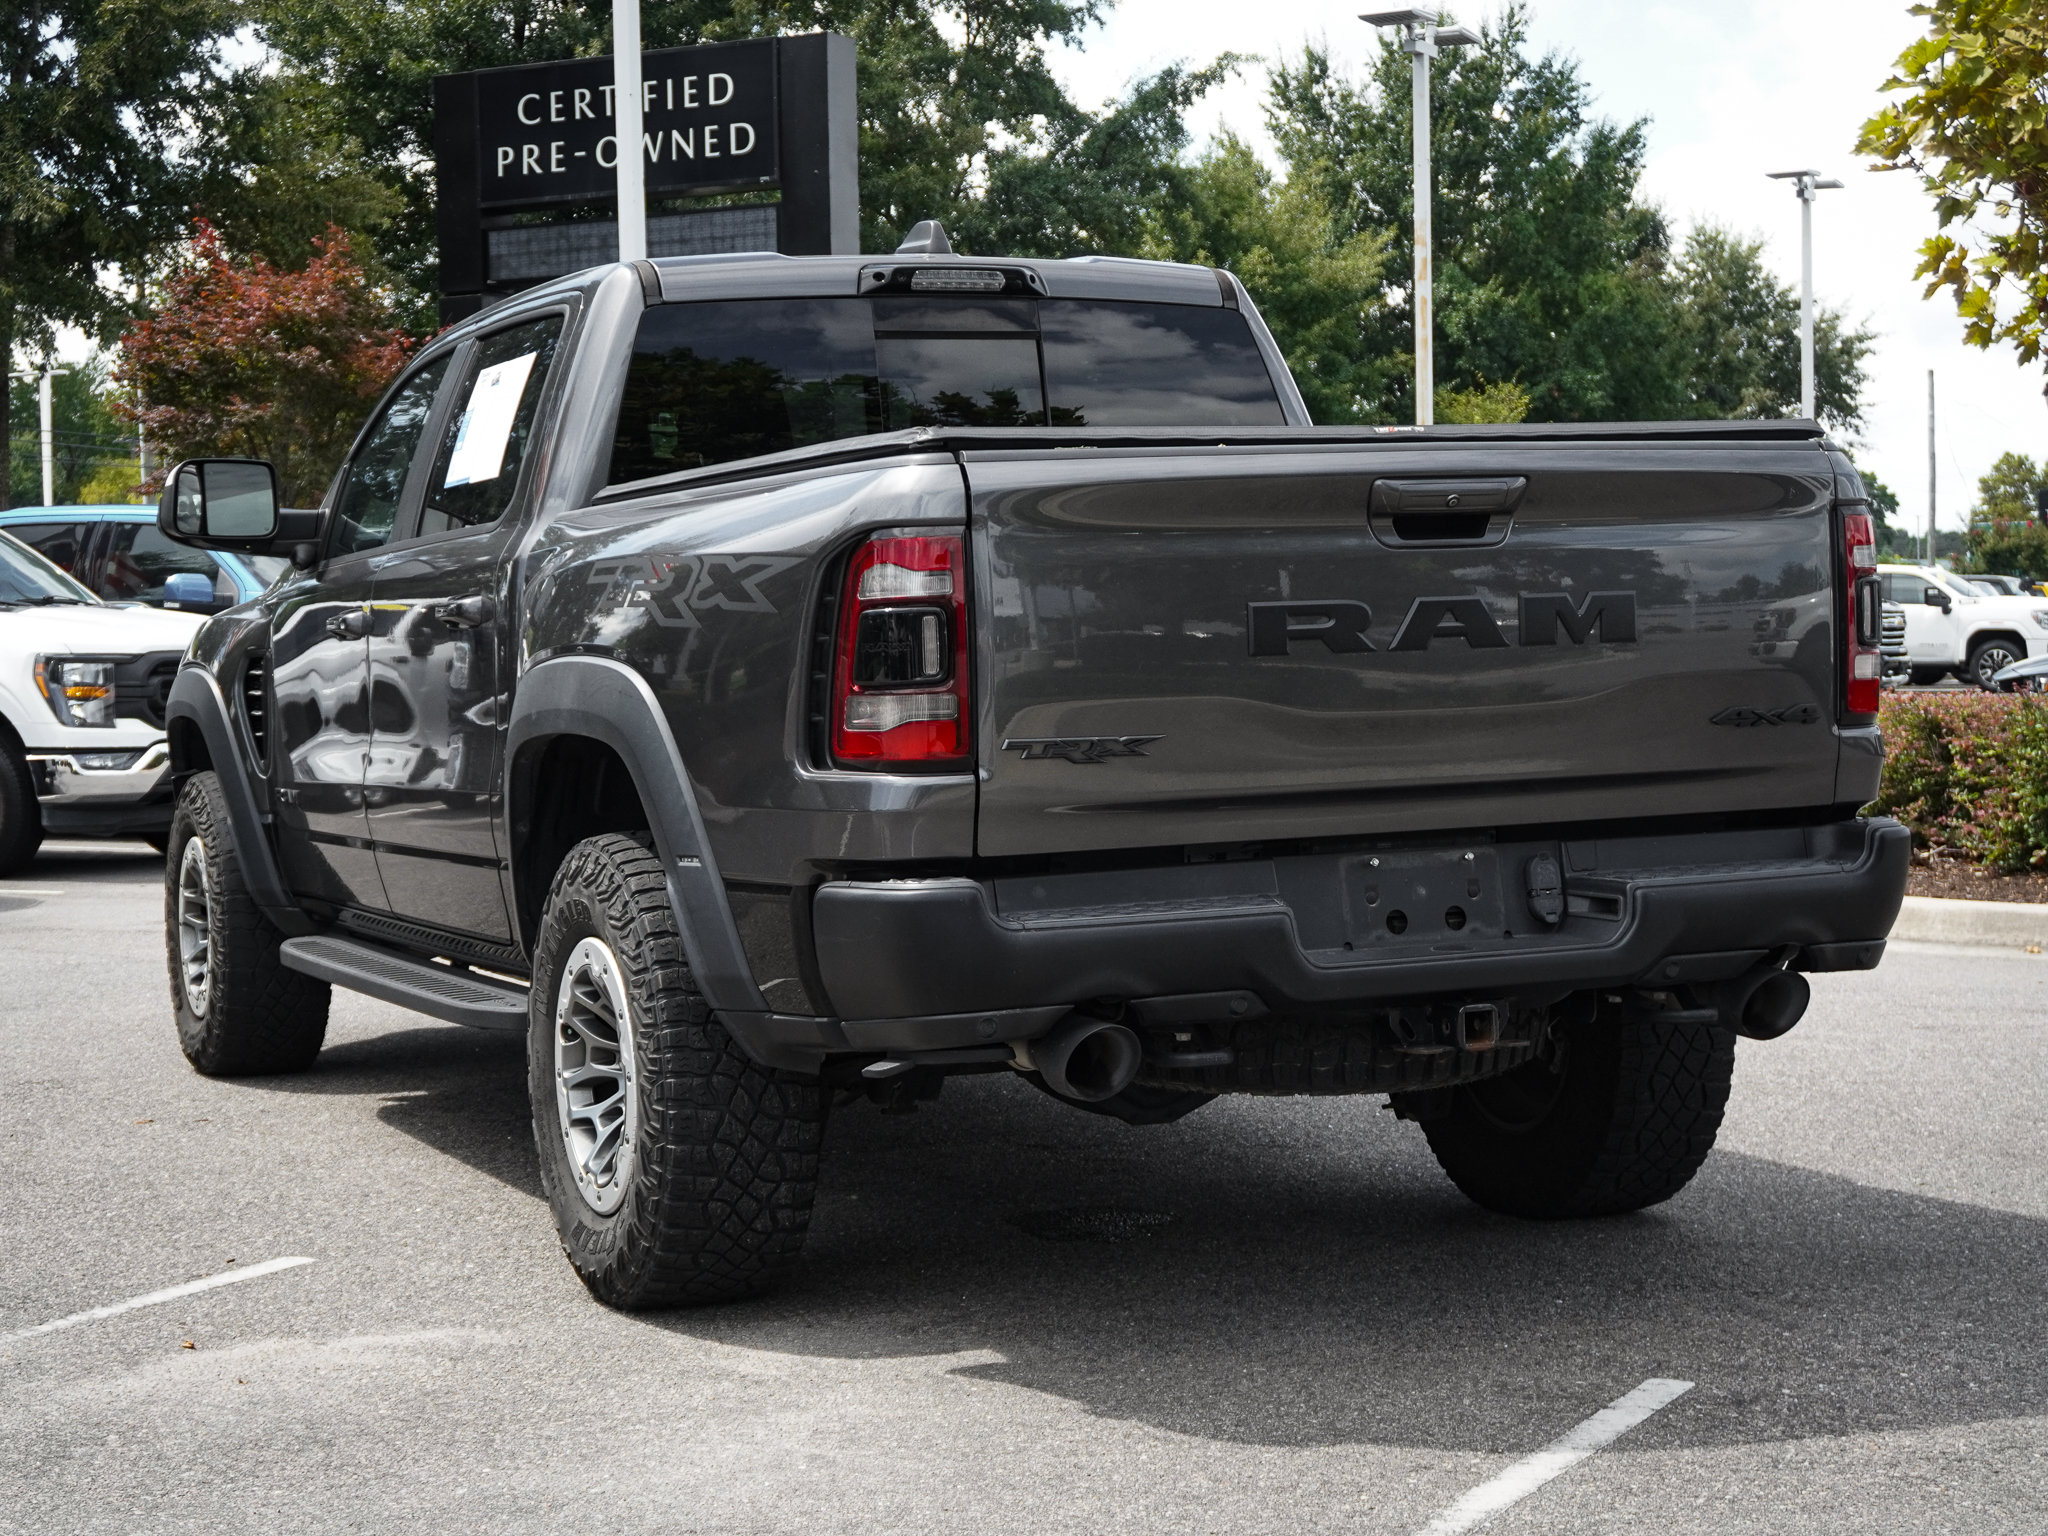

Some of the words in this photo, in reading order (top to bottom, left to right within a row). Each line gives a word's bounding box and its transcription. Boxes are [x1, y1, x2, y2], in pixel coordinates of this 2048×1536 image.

[517, 73, 735, 125] CERTFIED
[497, 122, 756, 178] PRE-OWNED
[587, 554, 807, 628] TRX
[1248, 591, 1637, 656] RAM
[1001, 734, 1167, 764] TRX
[535, 898, 593, 1015] WRANGLER
